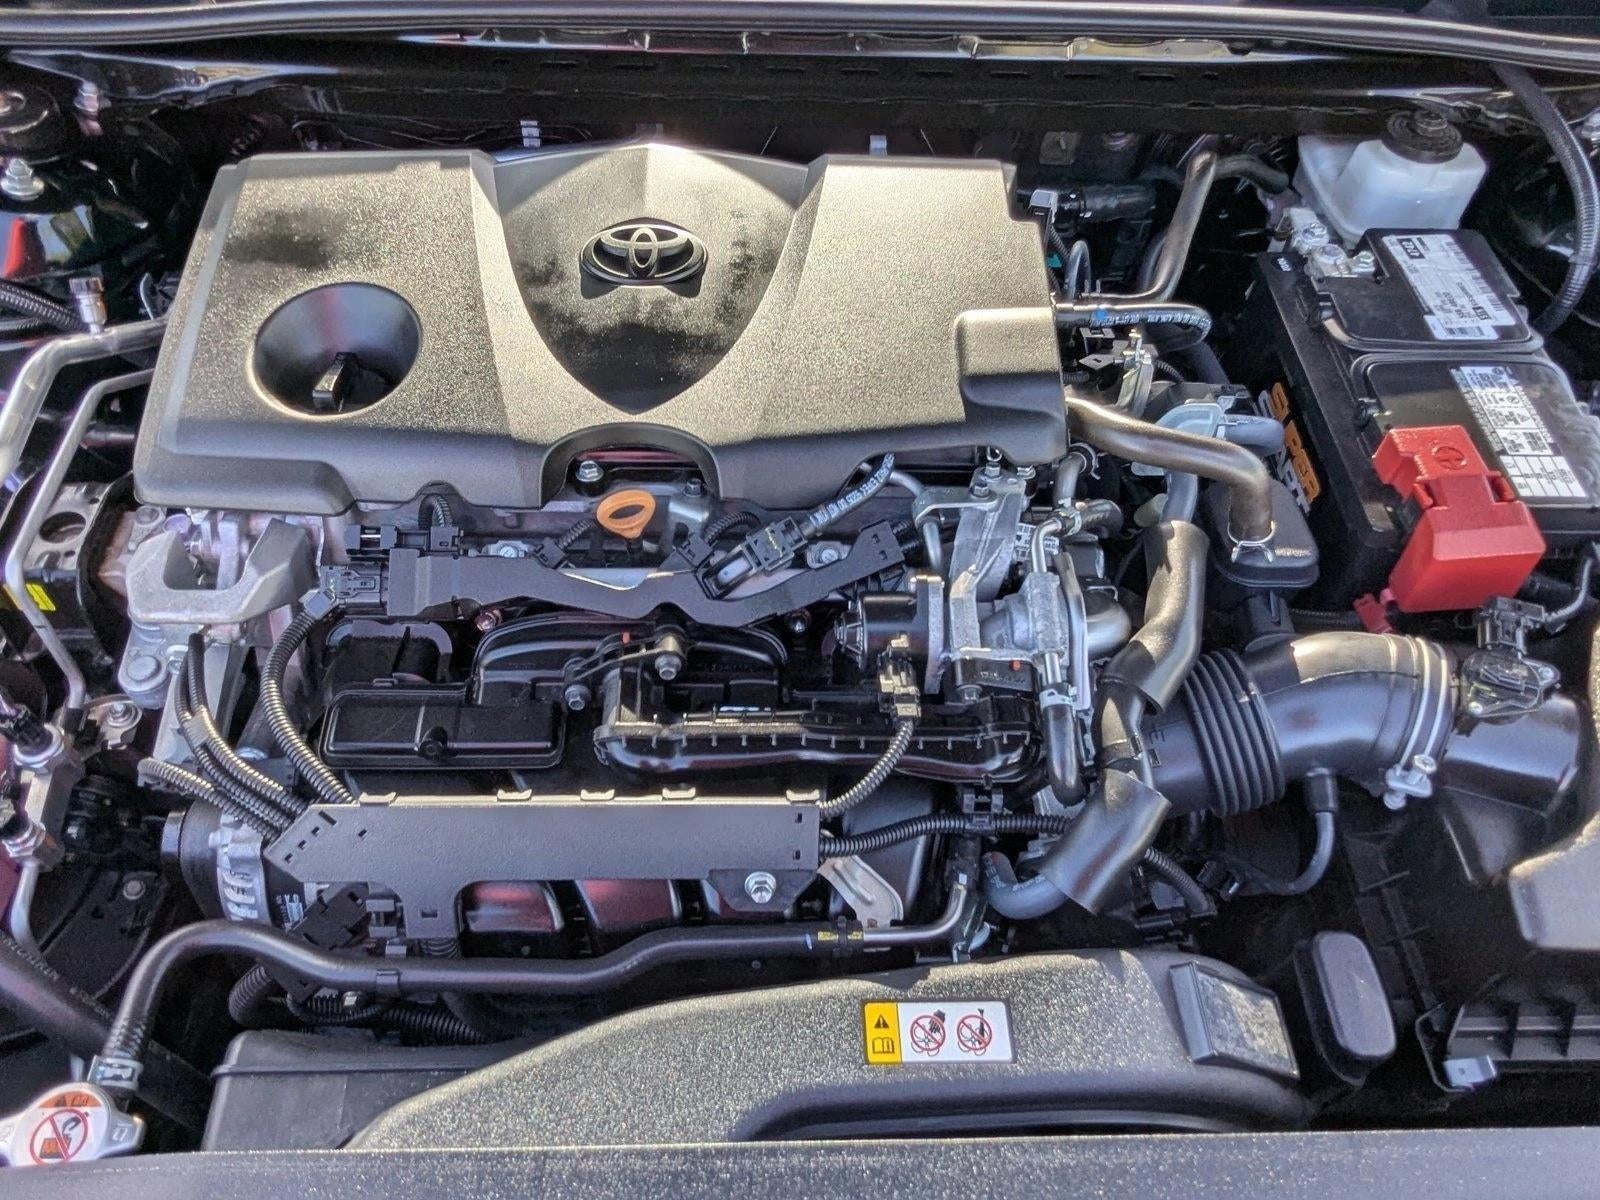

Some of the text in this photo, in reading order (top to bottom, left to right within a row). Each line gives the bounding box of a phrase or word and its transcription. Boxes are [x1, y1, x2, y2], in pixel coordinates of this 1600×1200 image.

[1258, 390, 1311, 514] SART
[1514, 385, 1554, 443] DANGER POISON
